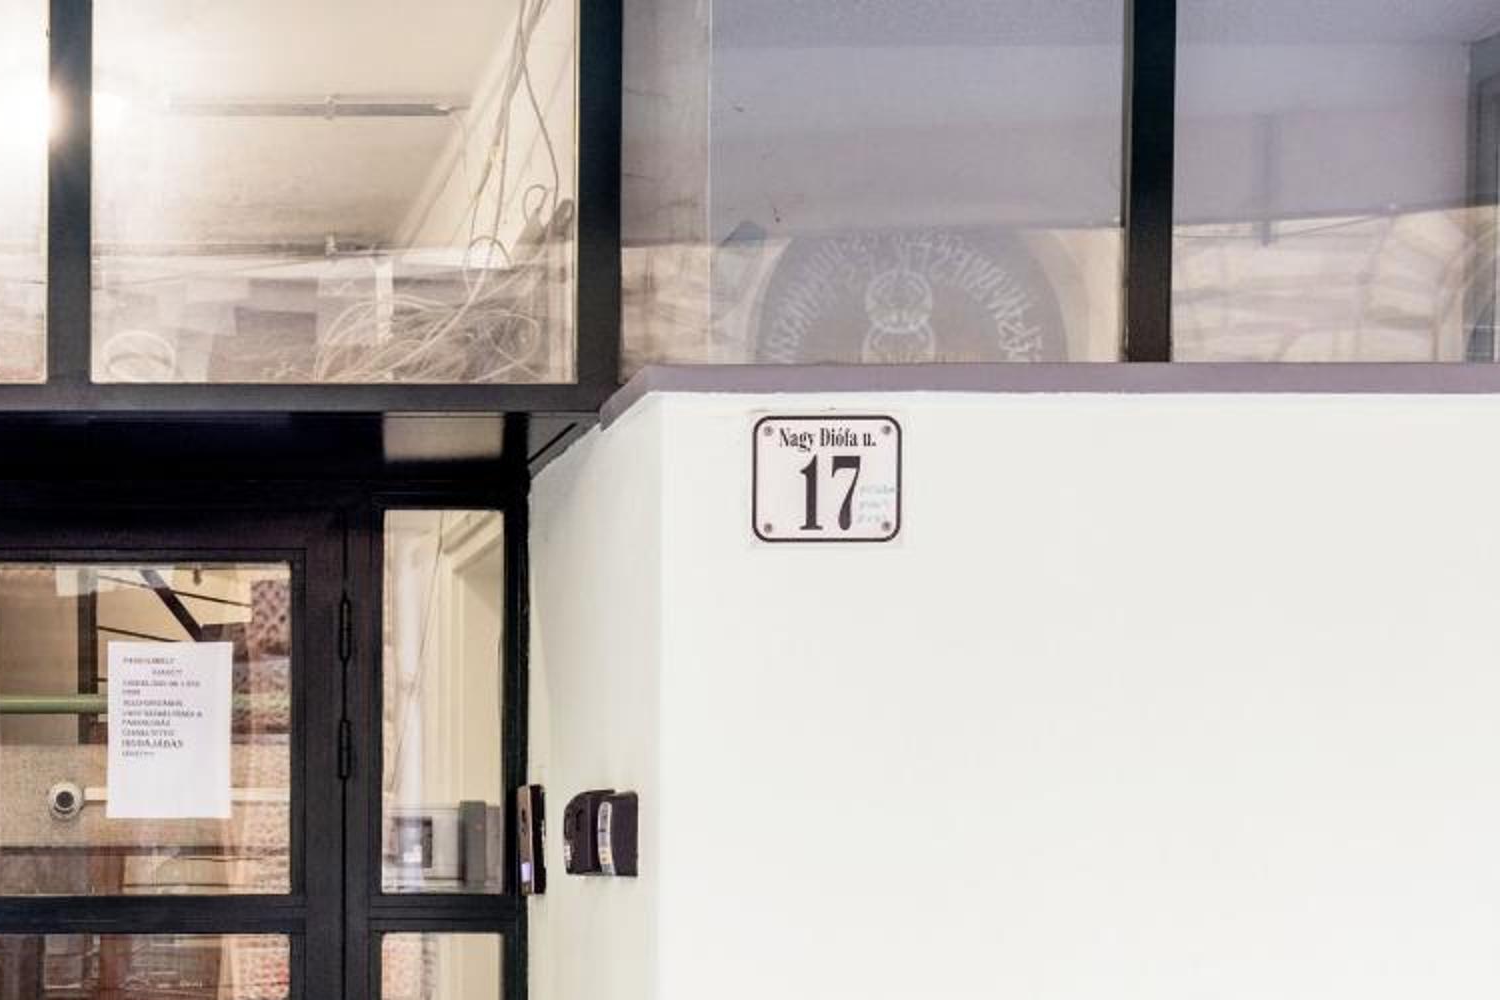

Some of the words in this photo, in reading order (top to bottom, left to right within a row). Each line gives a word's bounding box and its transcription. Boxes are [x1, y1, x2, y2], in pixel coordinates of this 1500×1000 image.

[779, 427, 815, 452] Nagy
[820, 427, 859, 447] Diófa
[863, 432, 877, 447] u.
[799, 453, 861, 531] 17
